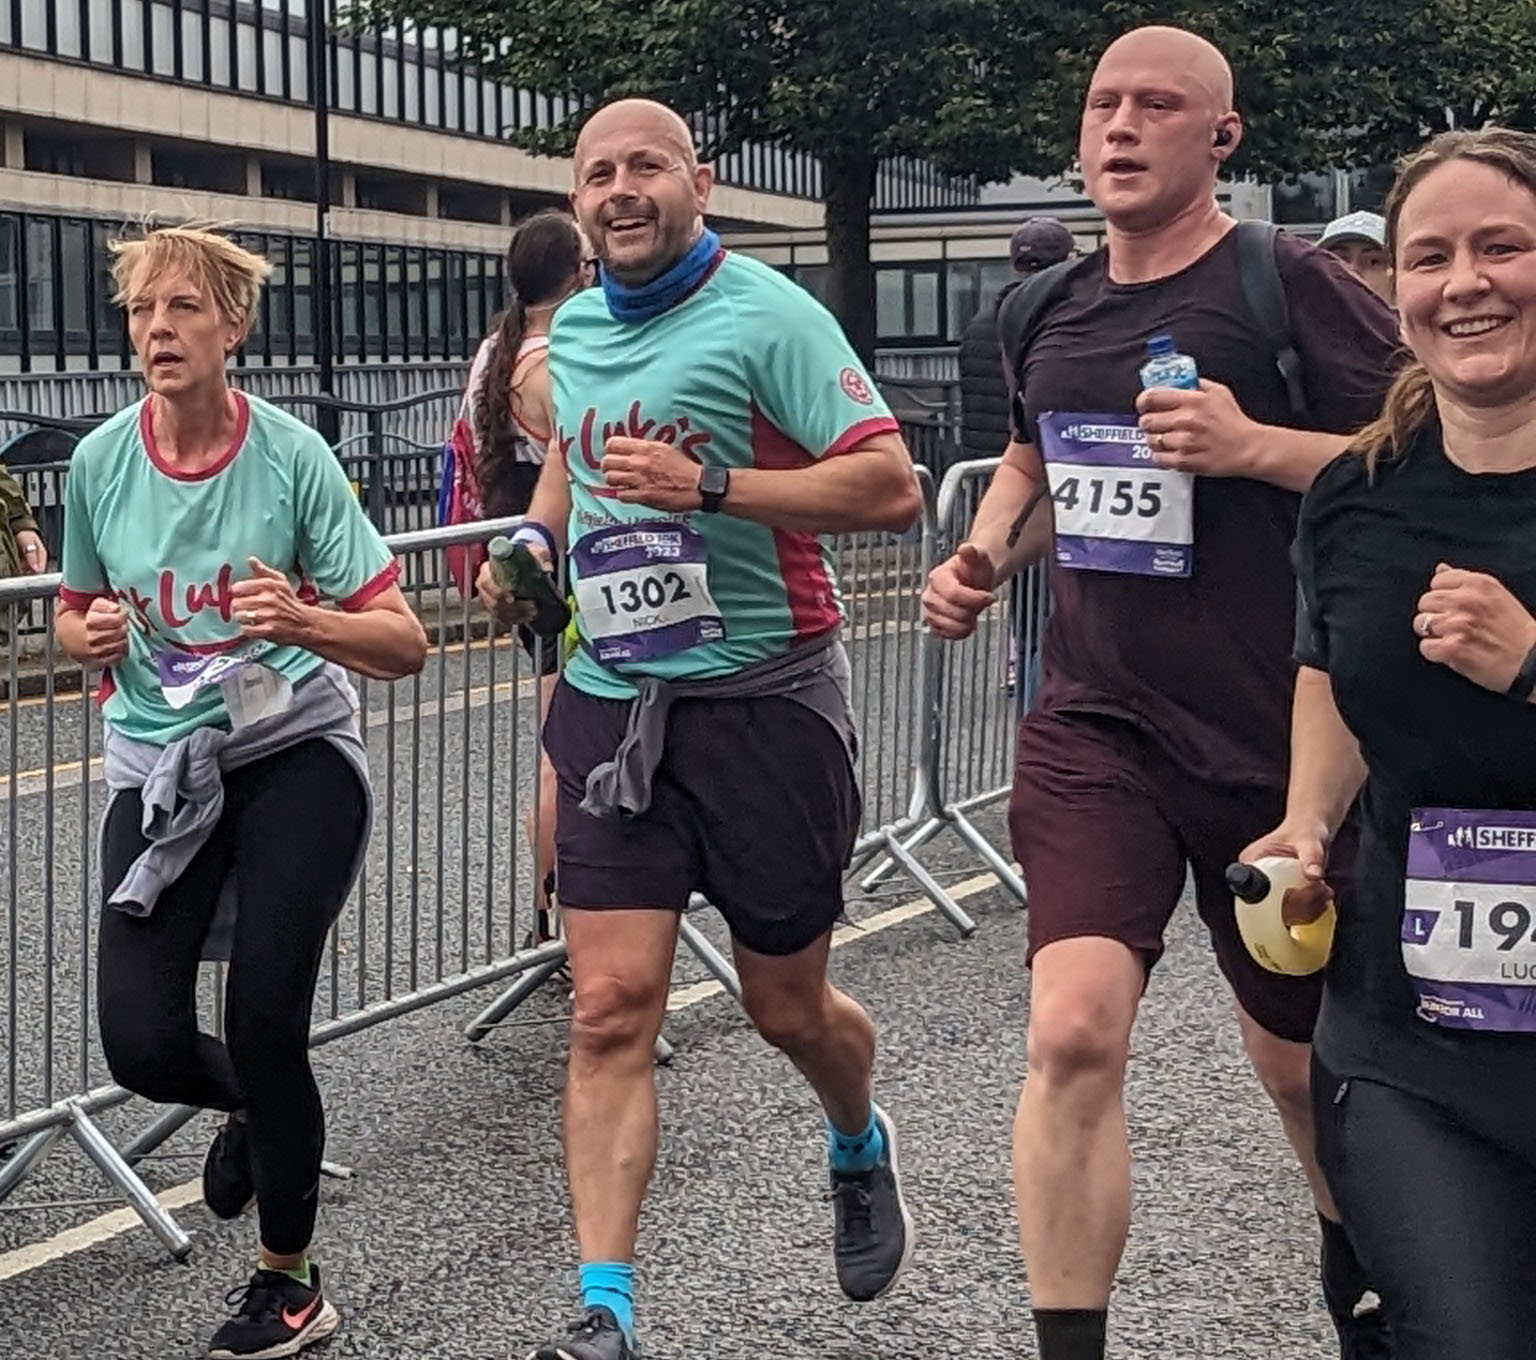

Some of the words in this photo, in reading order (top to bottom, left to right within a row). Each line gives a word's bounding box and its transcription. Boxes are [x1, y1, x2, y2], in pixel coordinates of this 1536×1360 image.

[1053, 477, 1162, 518] 4155
[600, 572, 692, 615] 1302
[632, 614, 664, 629] NICK
[1415, 917, 1425, 935] L
[1462, 1007, 1485, 1019] ALL
